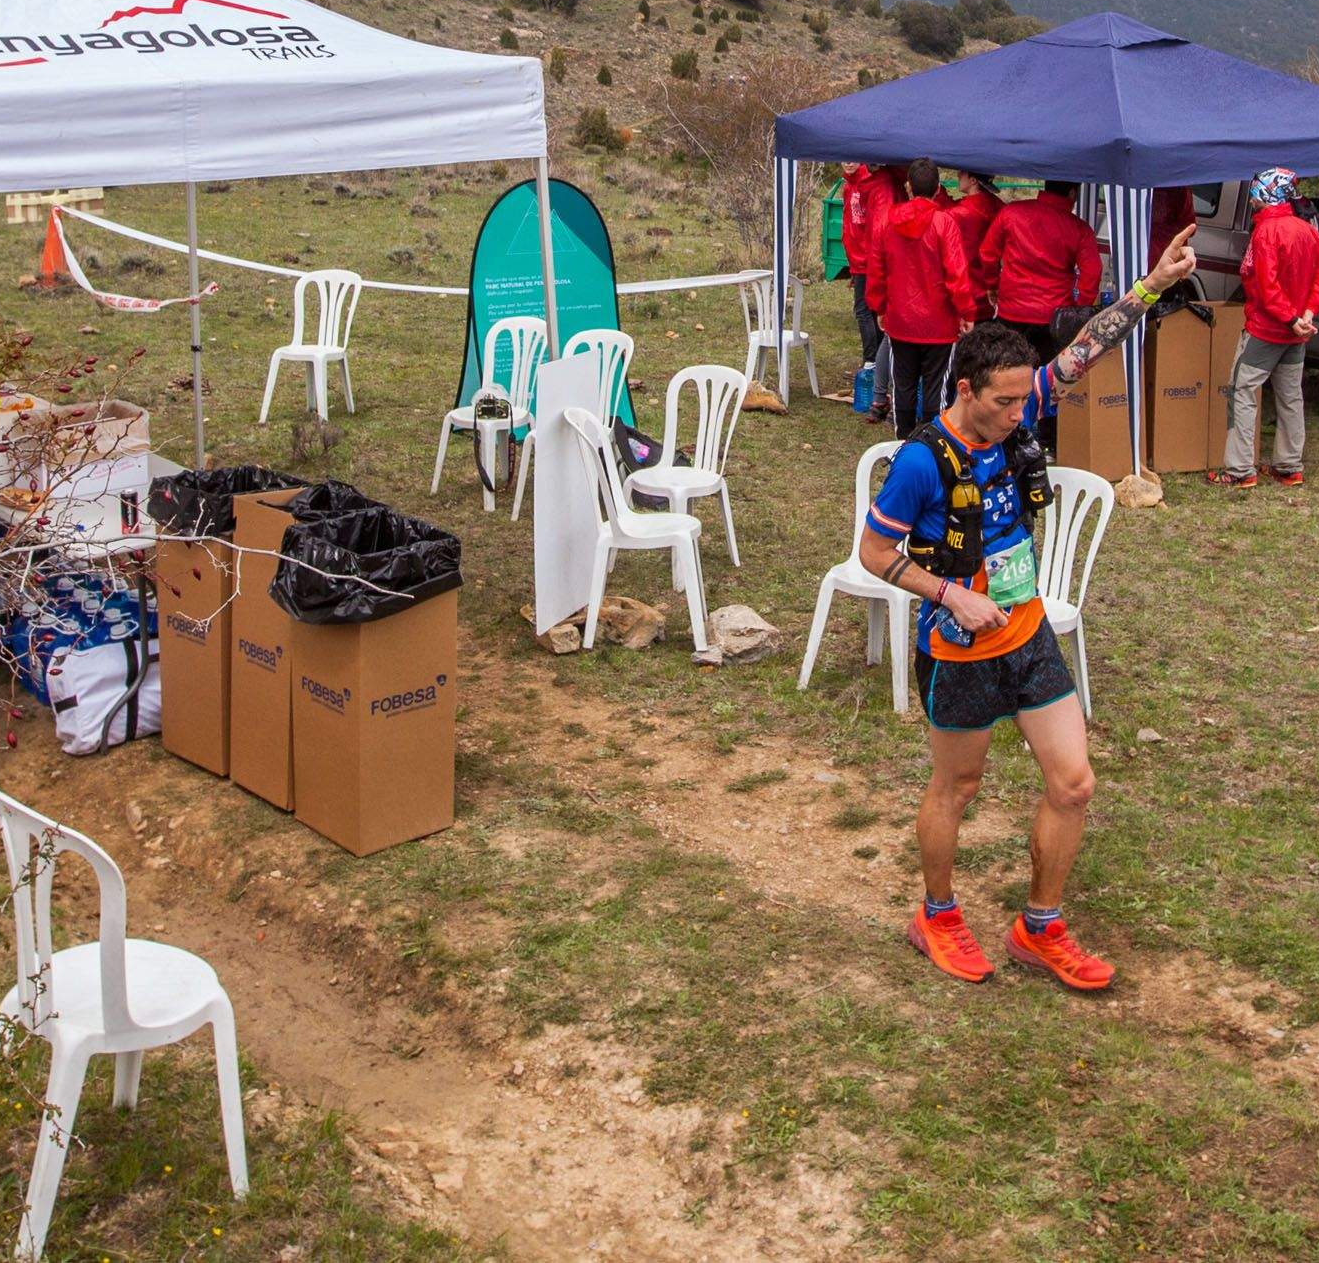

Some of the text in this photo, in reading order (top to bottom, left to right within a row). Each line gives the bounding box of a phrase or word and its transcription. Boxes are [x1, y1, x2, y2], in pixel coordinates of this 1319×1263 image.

[242, 43, 338, 62] TRAILS
[1001, 555, 1032, 582] 2163
[239, 639, 277, 667] FOBesa
[301, 676, 345, 708] FOBesa
[370, 685, 436, 715] FOBesa
